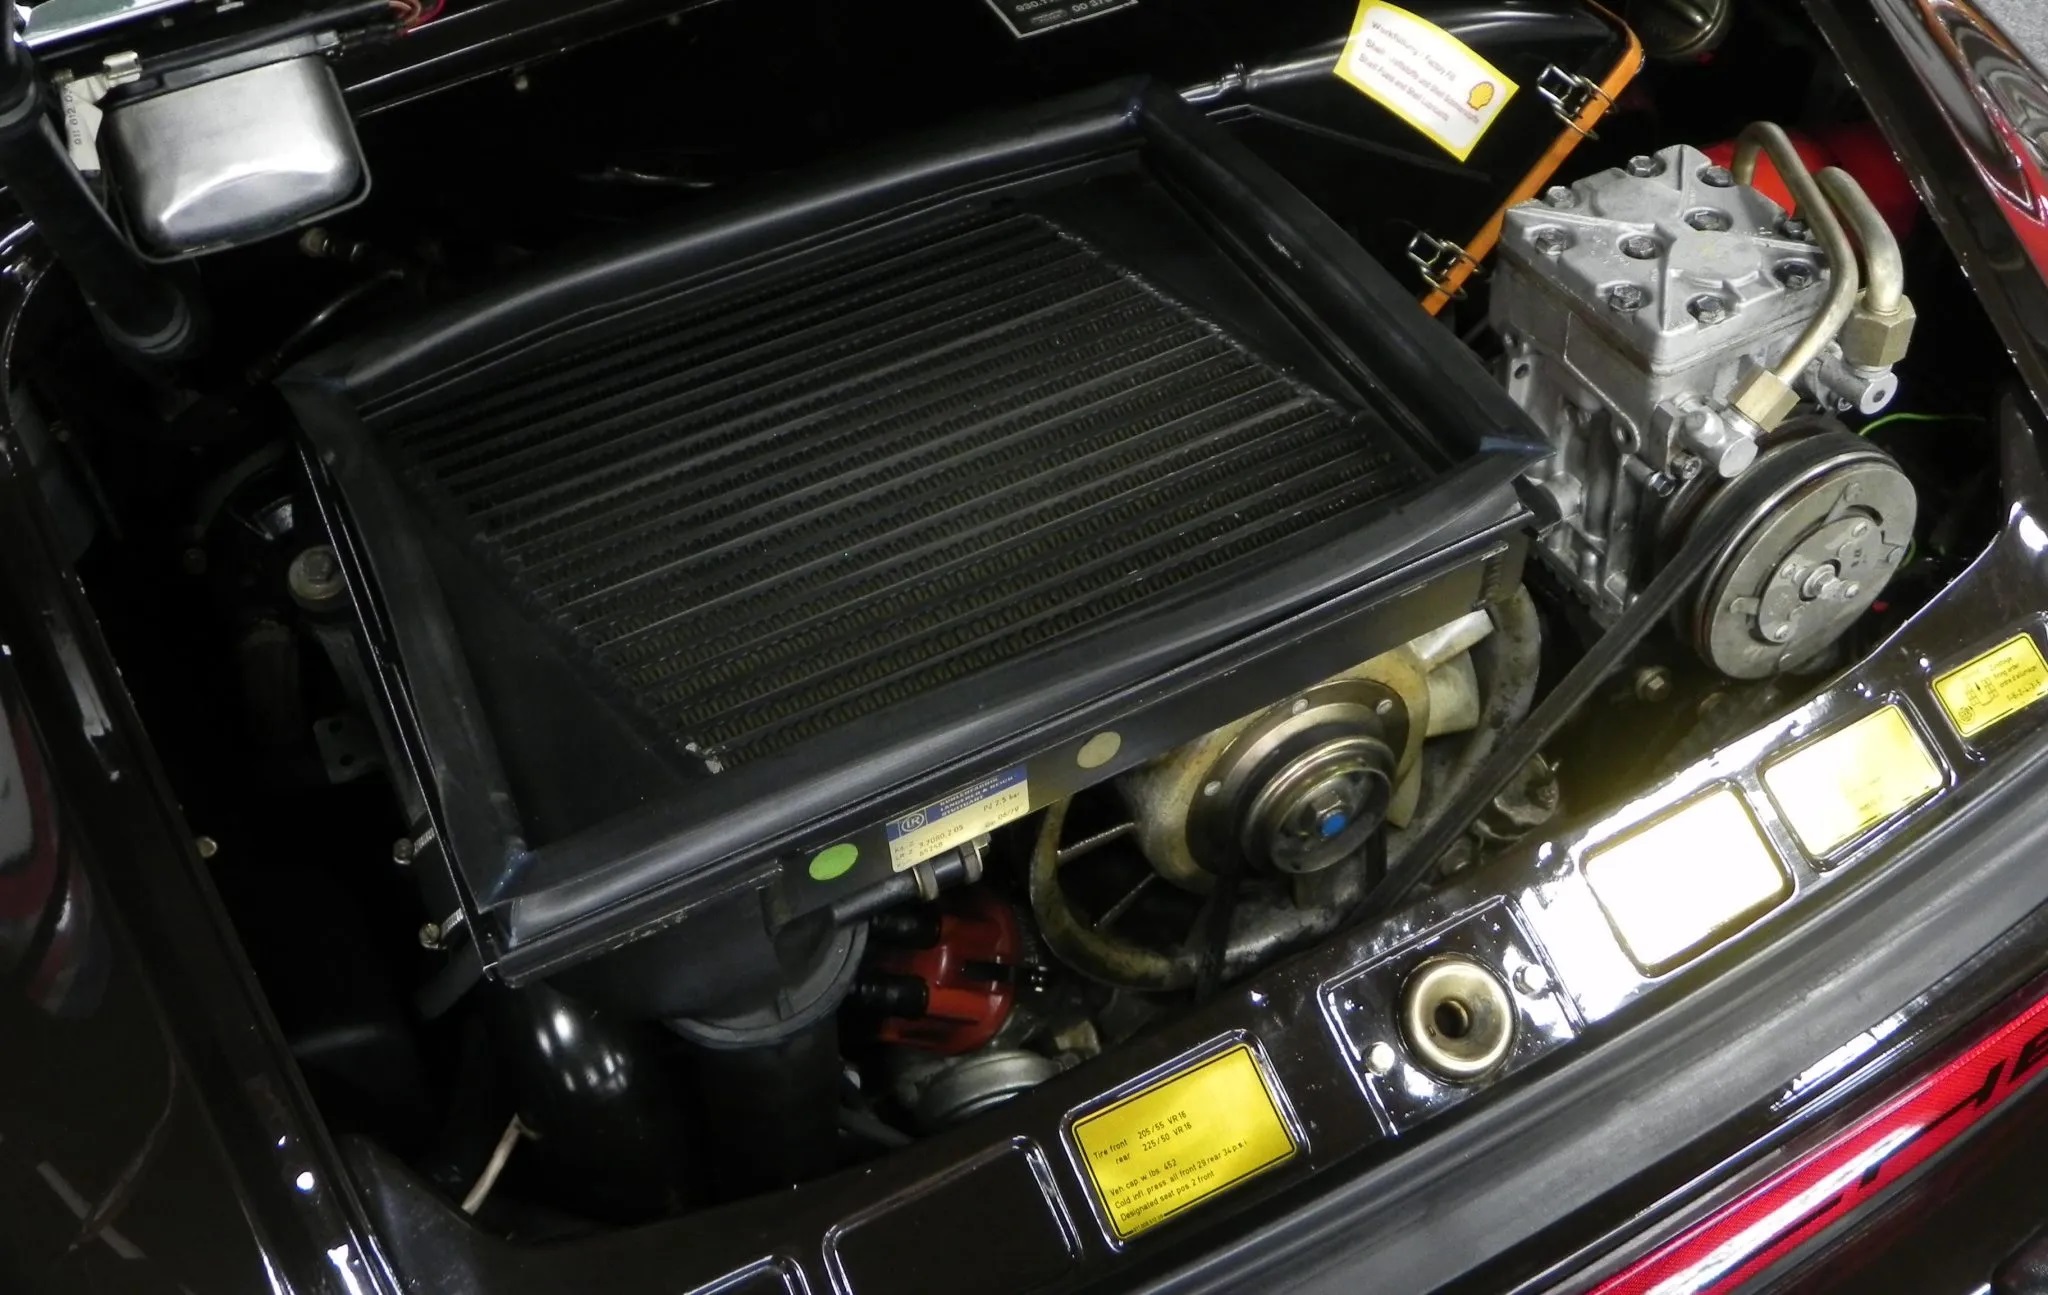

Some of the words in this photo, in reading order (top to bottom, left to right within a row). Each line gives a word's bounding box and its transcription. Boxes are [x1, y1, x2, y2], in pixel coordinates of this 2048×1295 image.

[1092, 1146, 1109, 1160] Tire
[1108, 1137, 1128, 1152] front
[1136, 1120, 1165, 1139] 205/55
[1113, 1151, 1131, 1165] rear
[1141, 1132, 1171, 1152] 225/50
[1162, 1158, 1177, 1170] 452
[1113, 1195, 1131, 1209] Cold
[1178, 1163, 1197, 1177] front
[1119, 1197, 1159, 1222] Designated
[1158, 1189, 1175, 1202] seat
[1196, 1169, 1215, 1183] front
